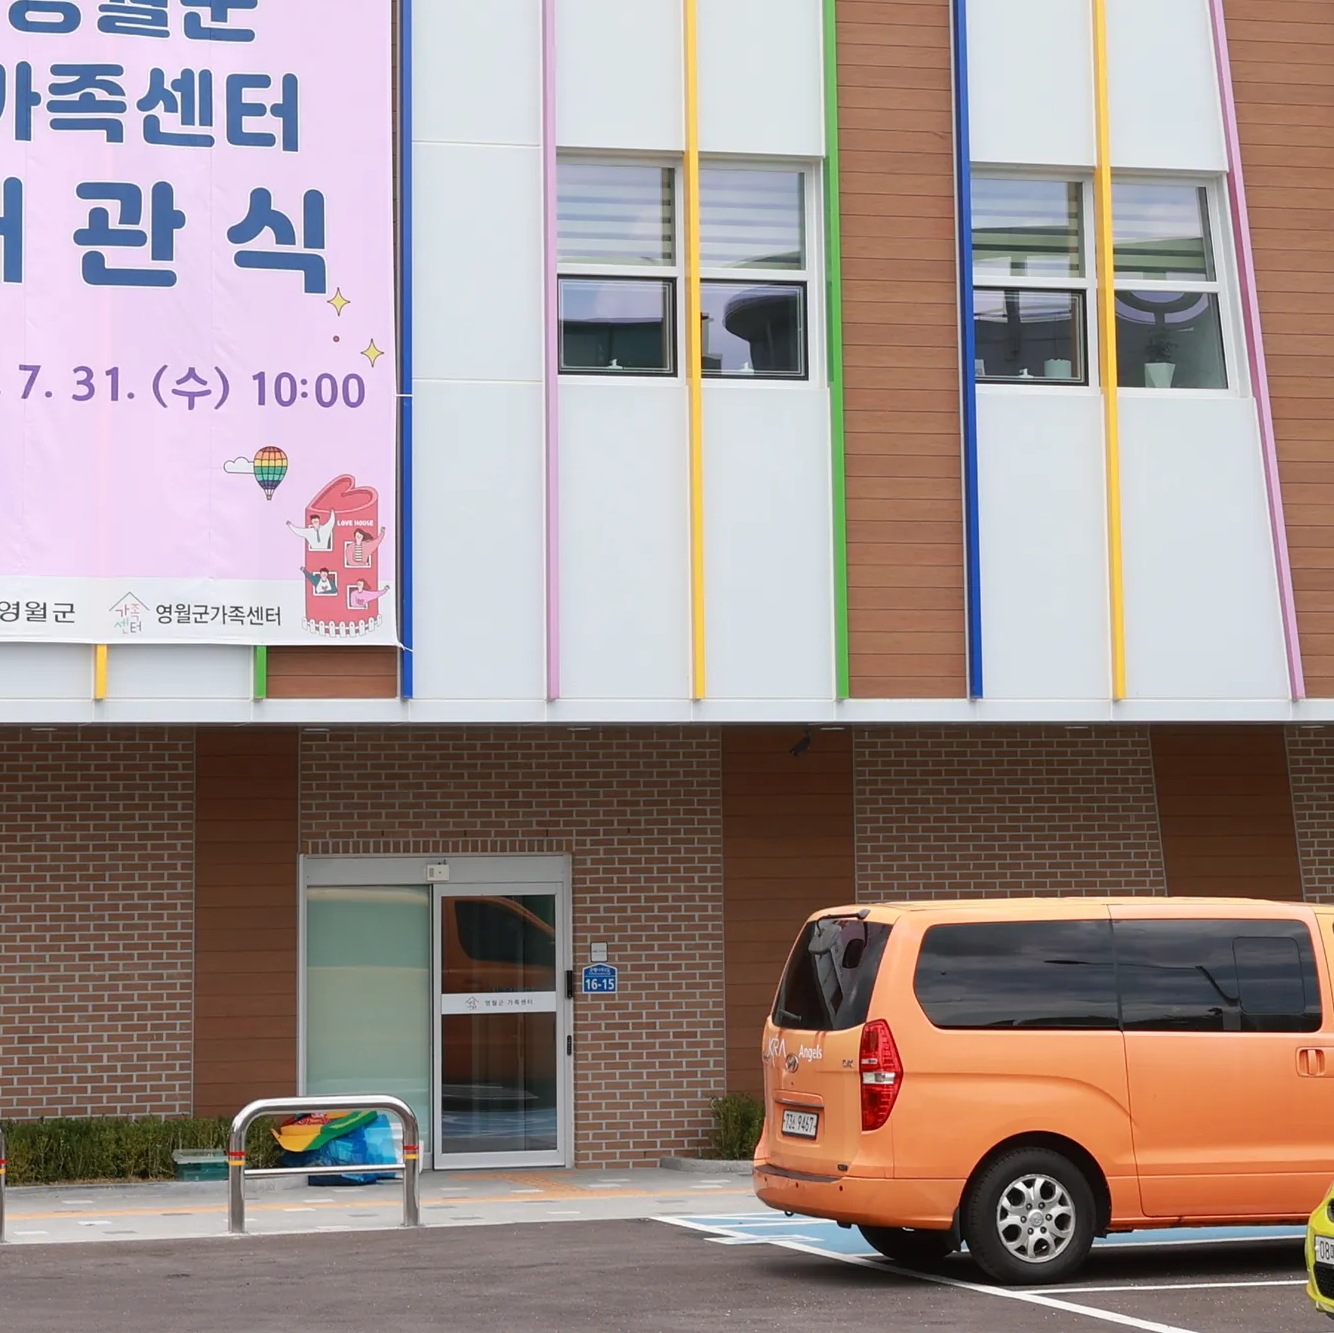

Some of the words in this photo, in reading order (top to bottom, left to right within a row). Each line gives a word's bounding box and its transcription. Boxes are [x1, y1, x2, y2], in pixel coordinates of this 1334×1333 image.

[152, 364, 230, 411] (수)
[252, 371, 366, 408] 10:00
[155, 602, 282, 626] 영월군가족센터
[585, 978, 615, 990] 16-15
[798, 1044, 822, 1062] Angels
